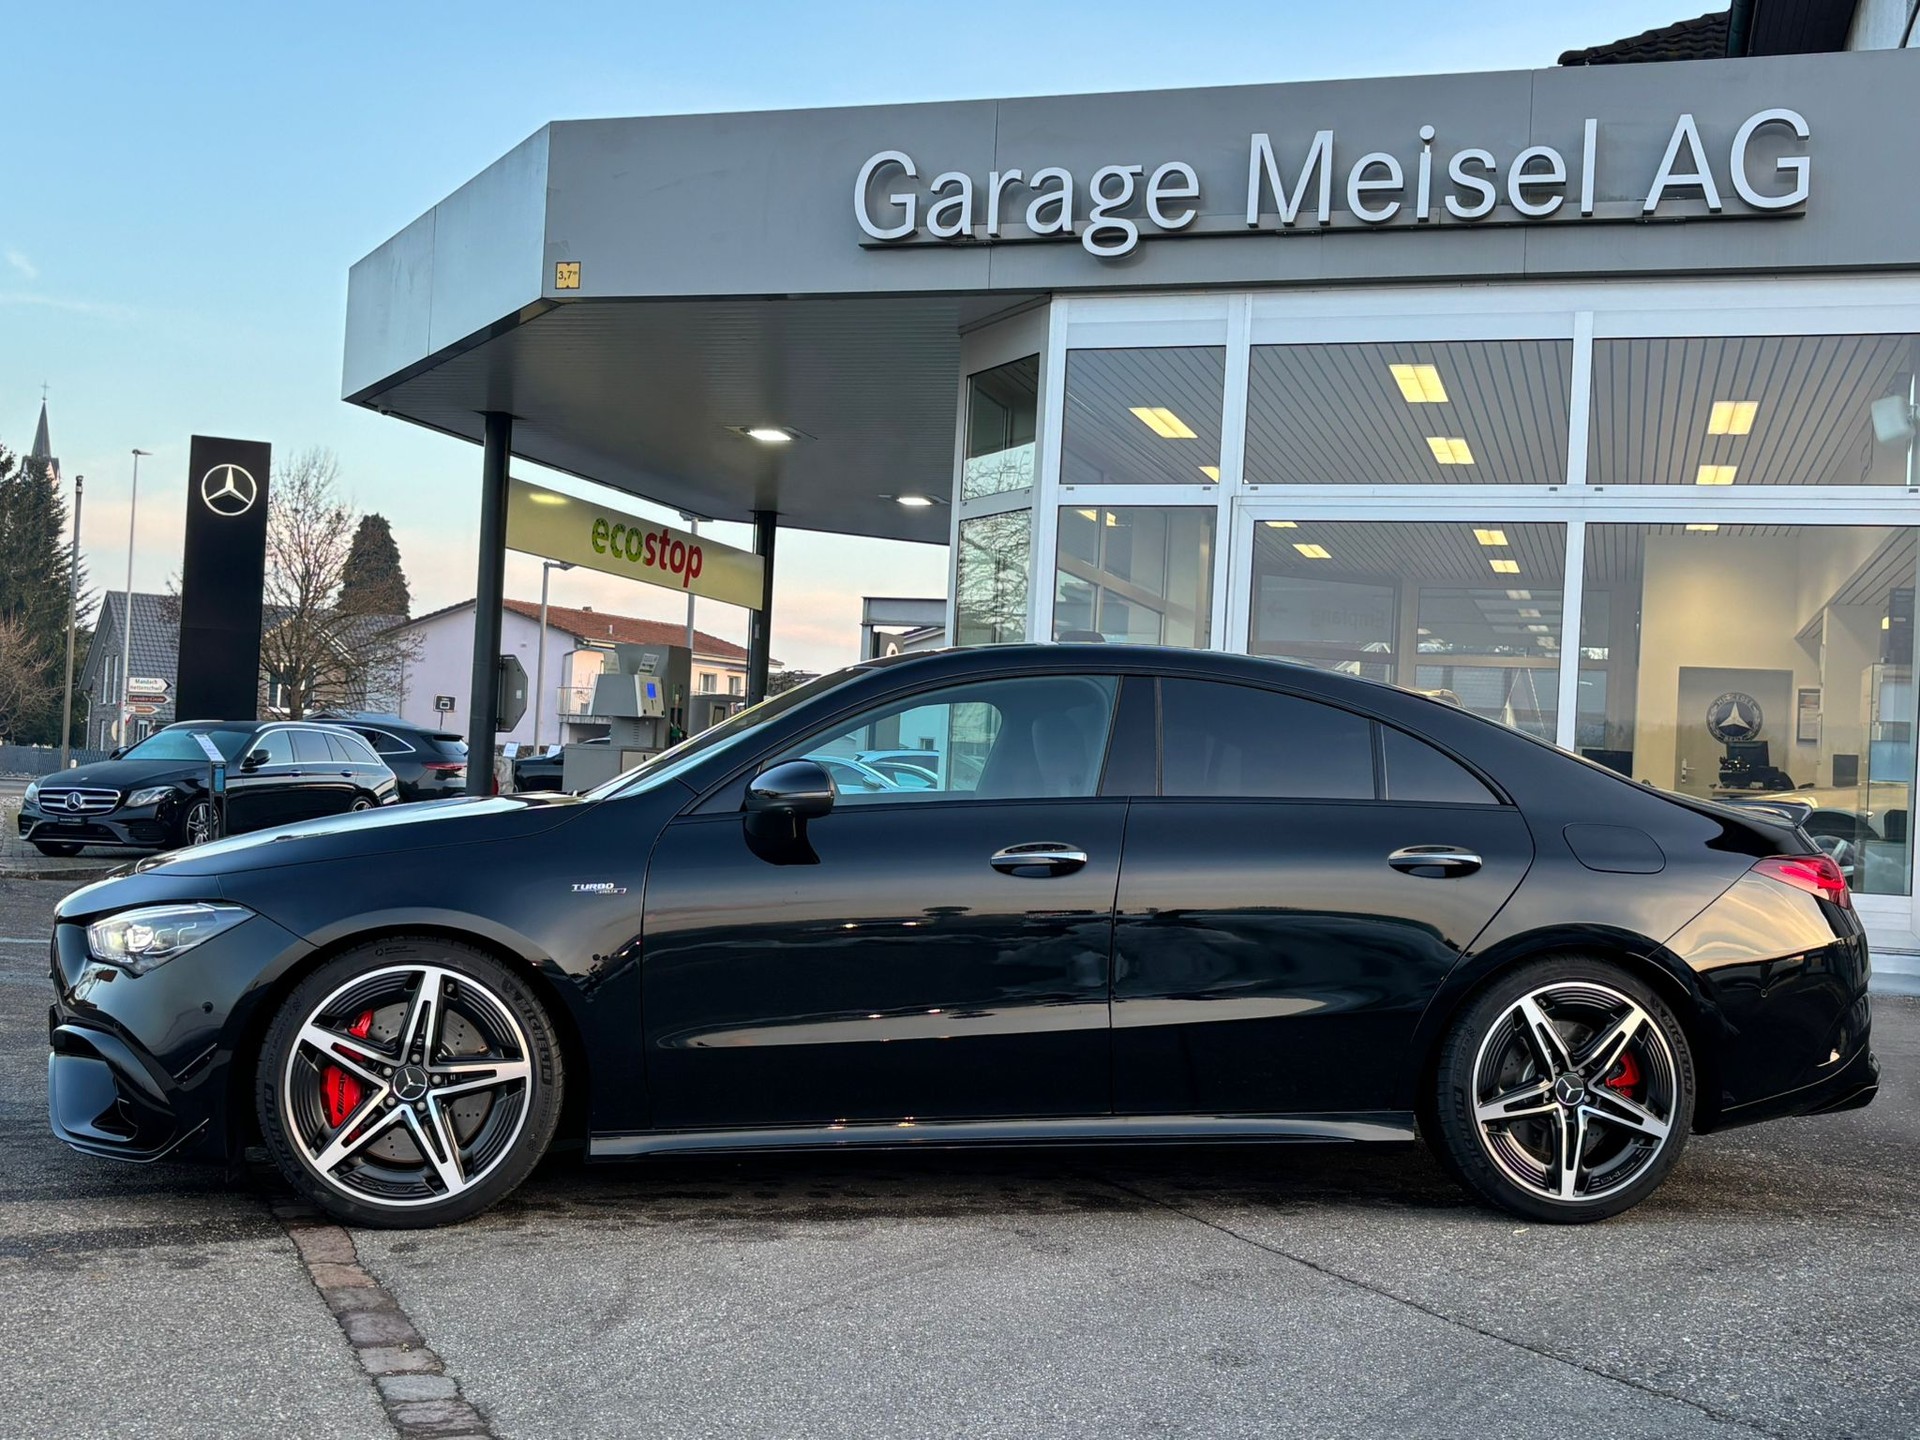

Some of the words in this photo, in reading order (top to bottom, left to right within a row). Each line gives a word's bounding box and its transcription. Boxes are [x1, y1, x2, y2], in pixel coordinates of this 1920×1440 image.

[853, 149, 1200, 259] Garage
[1245, 118, 1598, 228] Meisel
[1643, 108, 1811, 215] AG
[591, 517, 703, 588] ecostop
[571, 882, 615, 891] TURBO
[517, 996, 553, 1086] MICHELIN
